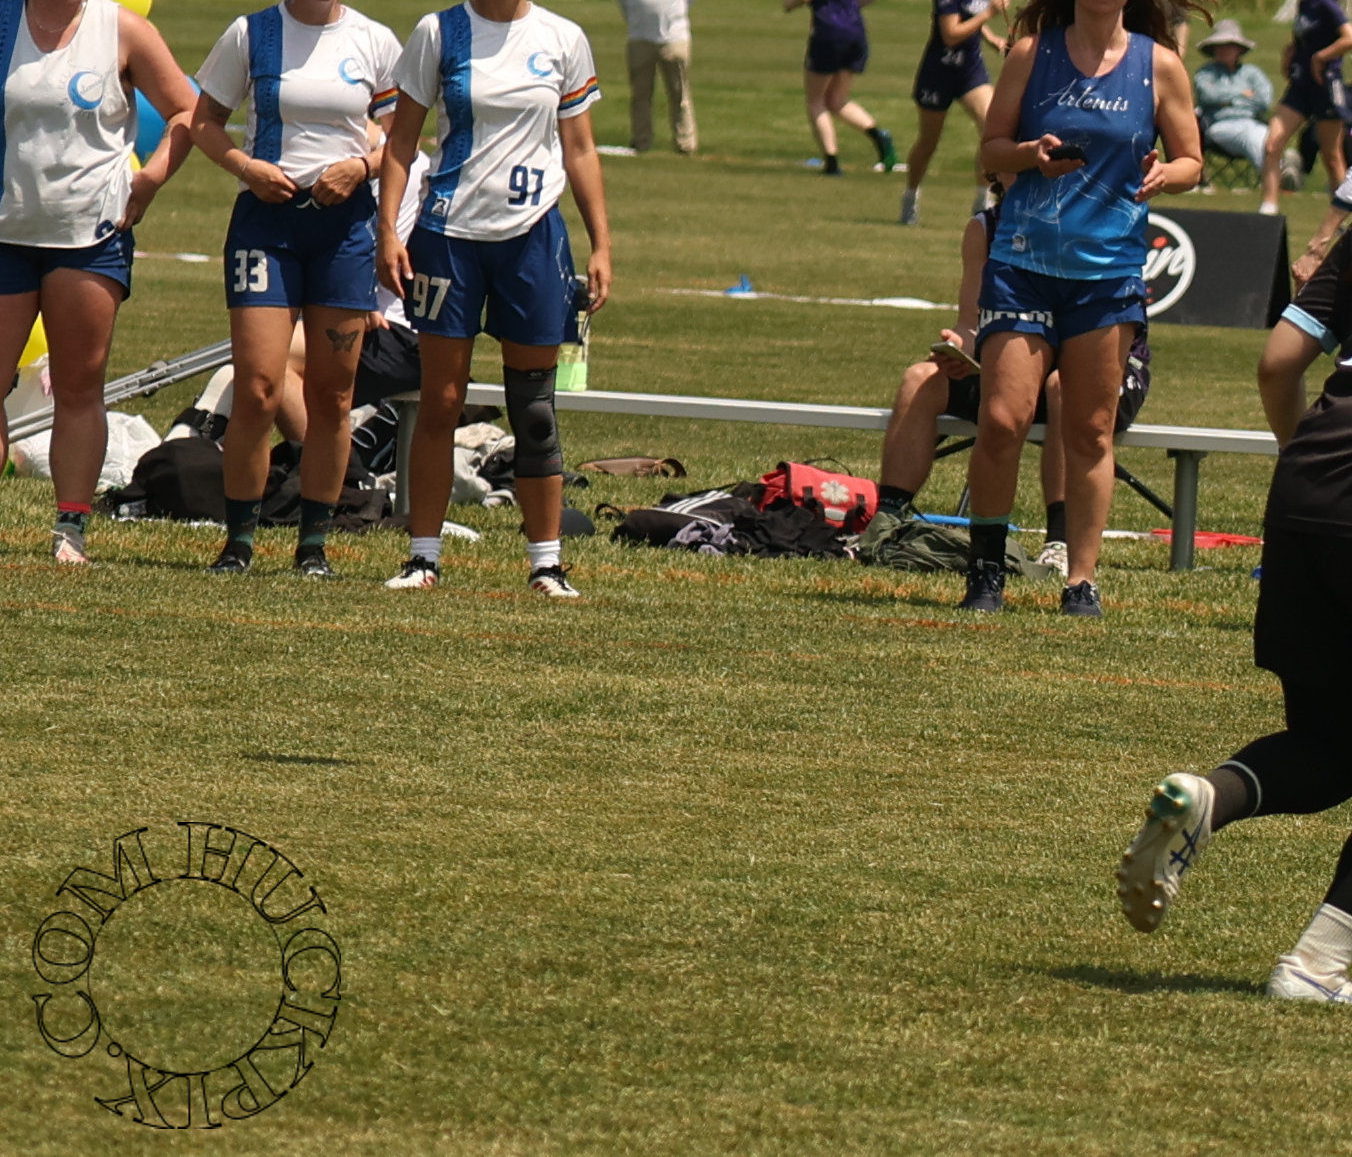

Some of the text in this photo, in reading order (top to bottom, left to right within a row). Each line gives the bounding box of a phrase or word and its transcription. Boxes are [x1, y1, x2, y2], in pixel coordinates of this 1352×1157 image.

[1039, 78, 1129, 112] Artemis
[508, 165, 545, 206] 97
[233, 249, 268, 293] 33
[412, 272, 452, 320] 97
